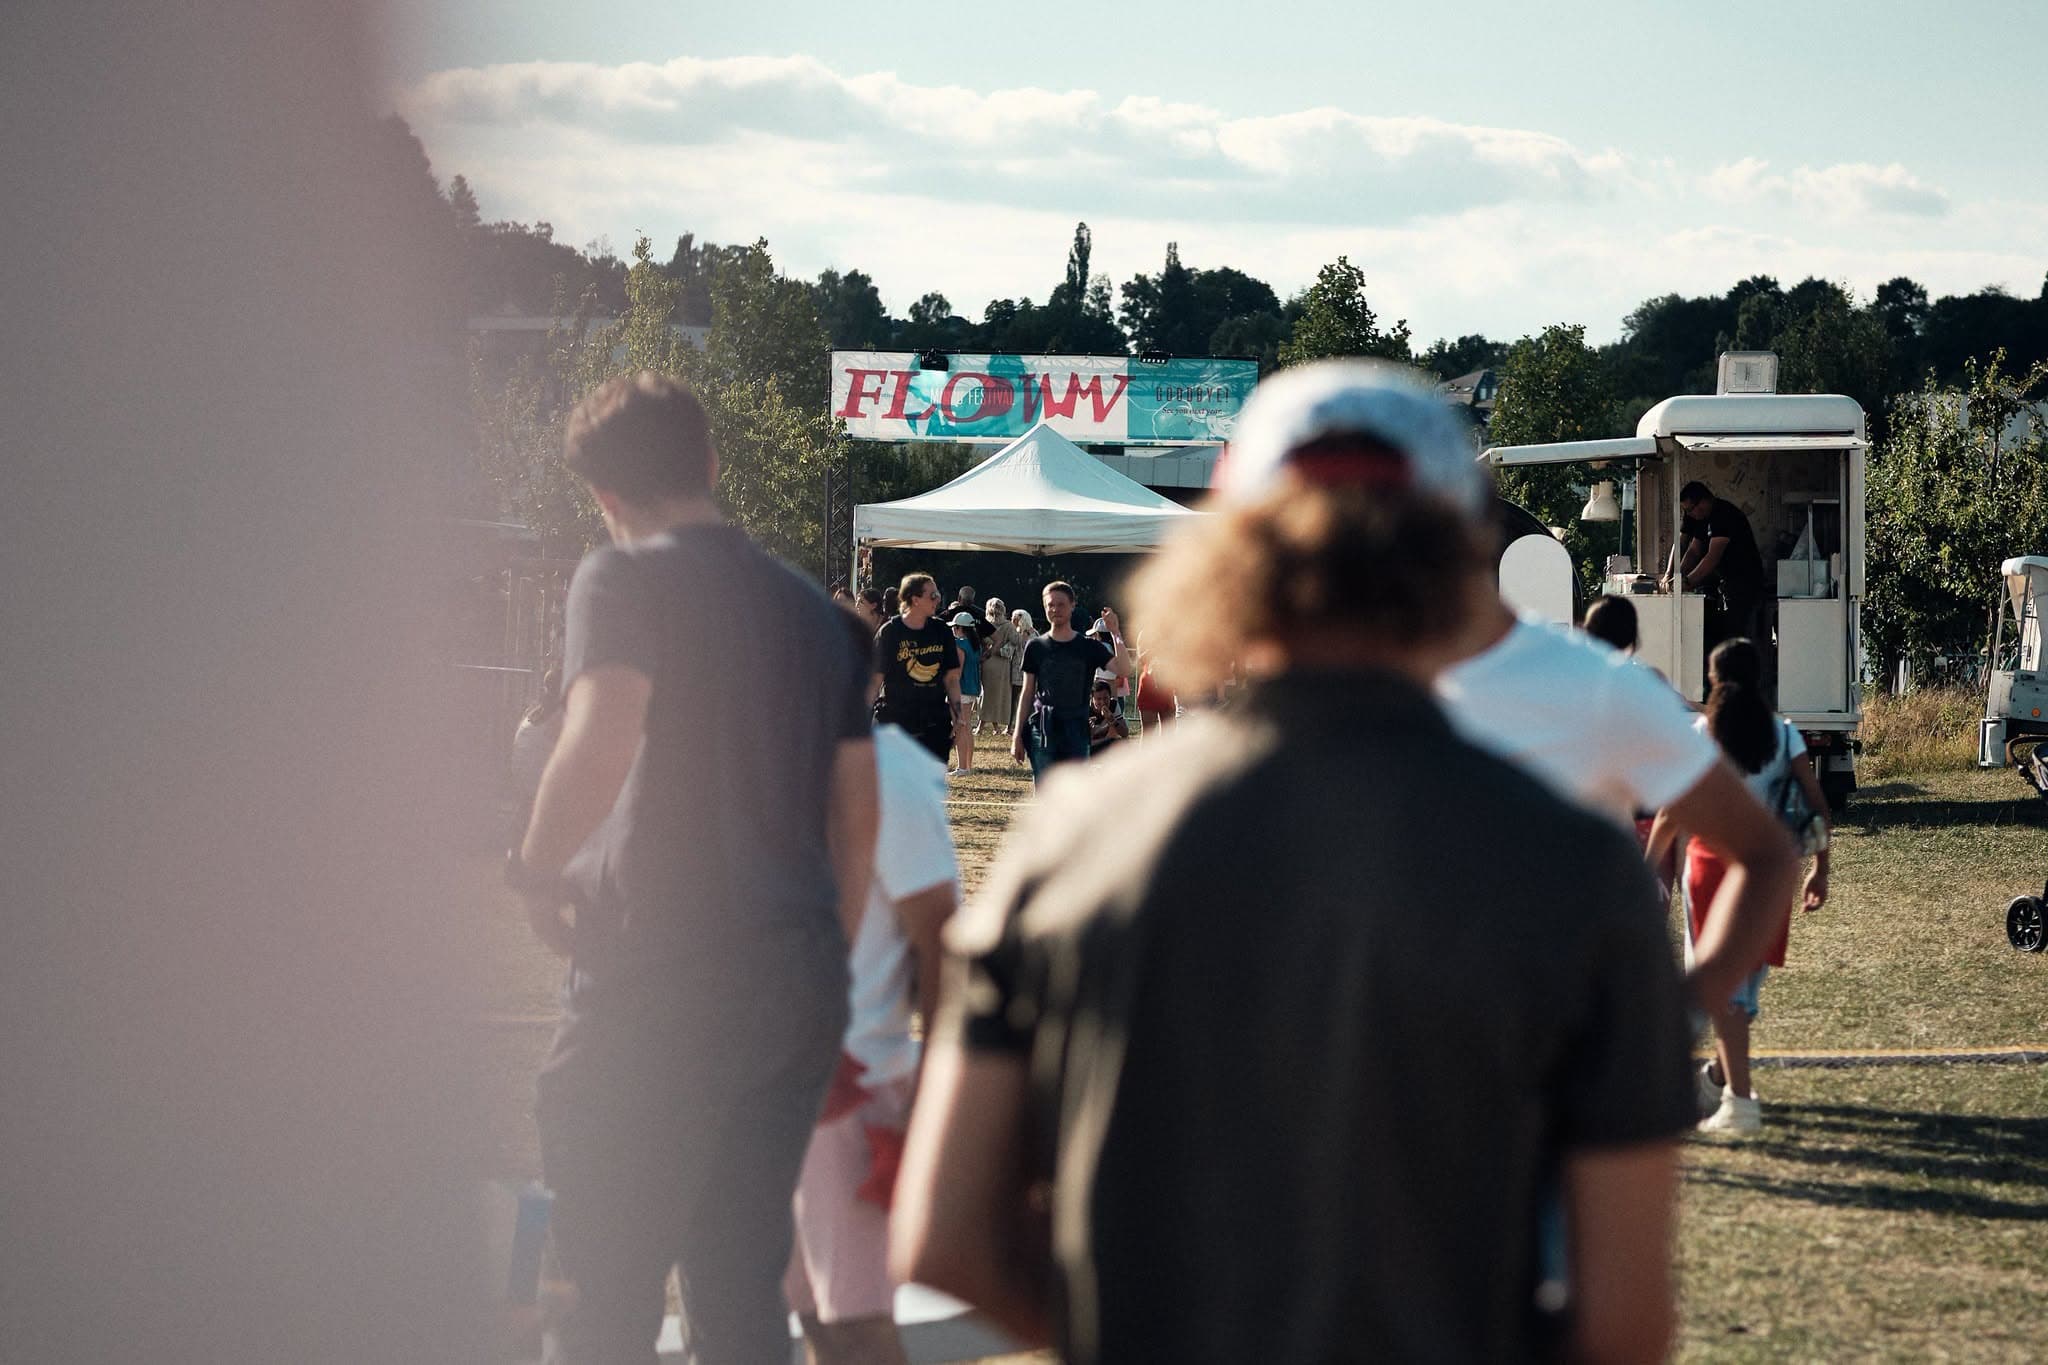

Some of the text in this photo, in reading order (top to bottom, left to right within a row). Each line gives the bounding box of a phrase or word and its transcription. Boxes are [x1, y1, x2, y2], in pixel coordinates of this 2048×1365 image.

[968, 387, 1016, 406] FESTIVAL
[1156, 386, 1230, 402] GOODBYE!
[1162, 406, 1174, 414] See
[1175, 408, 1188, 416] you
[1189, 407, 1205, 415] next
